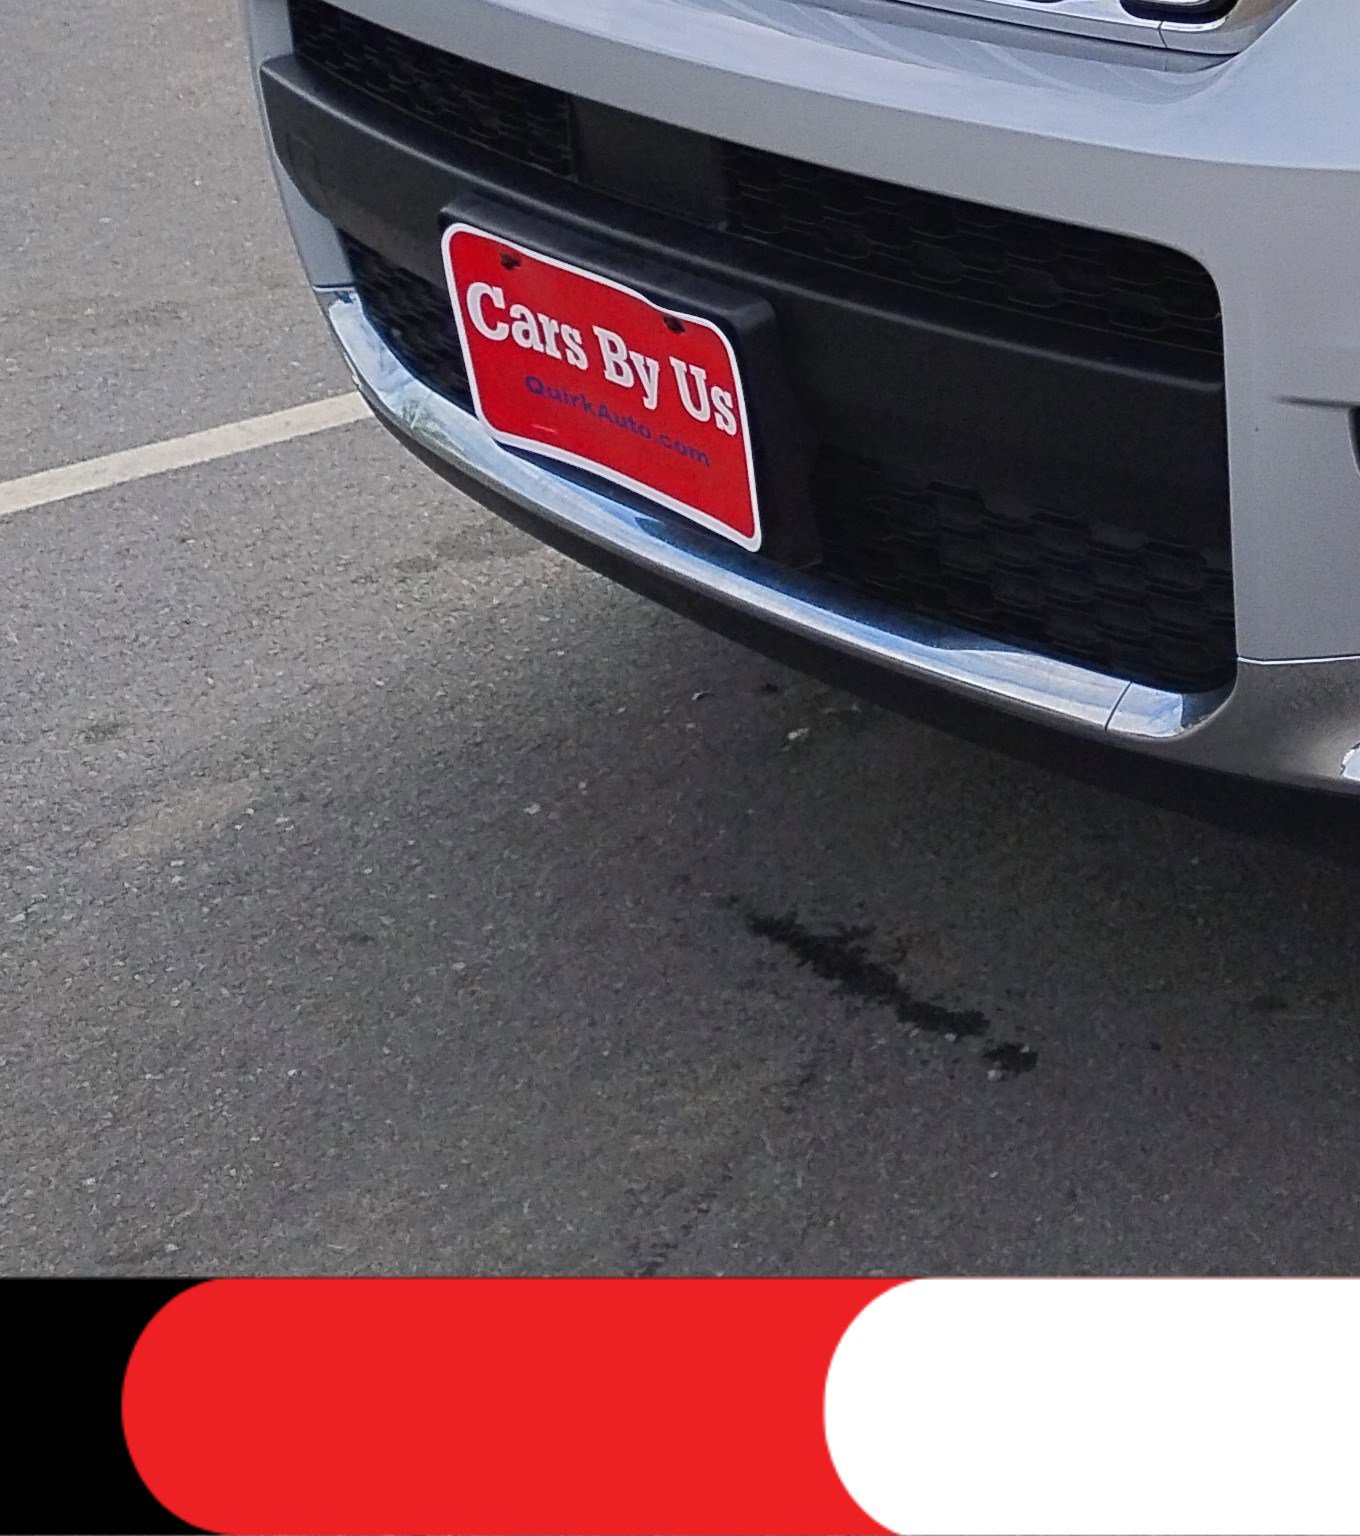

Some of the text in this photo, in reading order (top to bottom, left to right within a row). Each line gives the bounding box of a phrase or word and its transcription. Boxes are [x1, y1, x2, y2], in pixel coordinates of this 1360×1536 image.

[466, 281, 738, 436] Cars By Us
